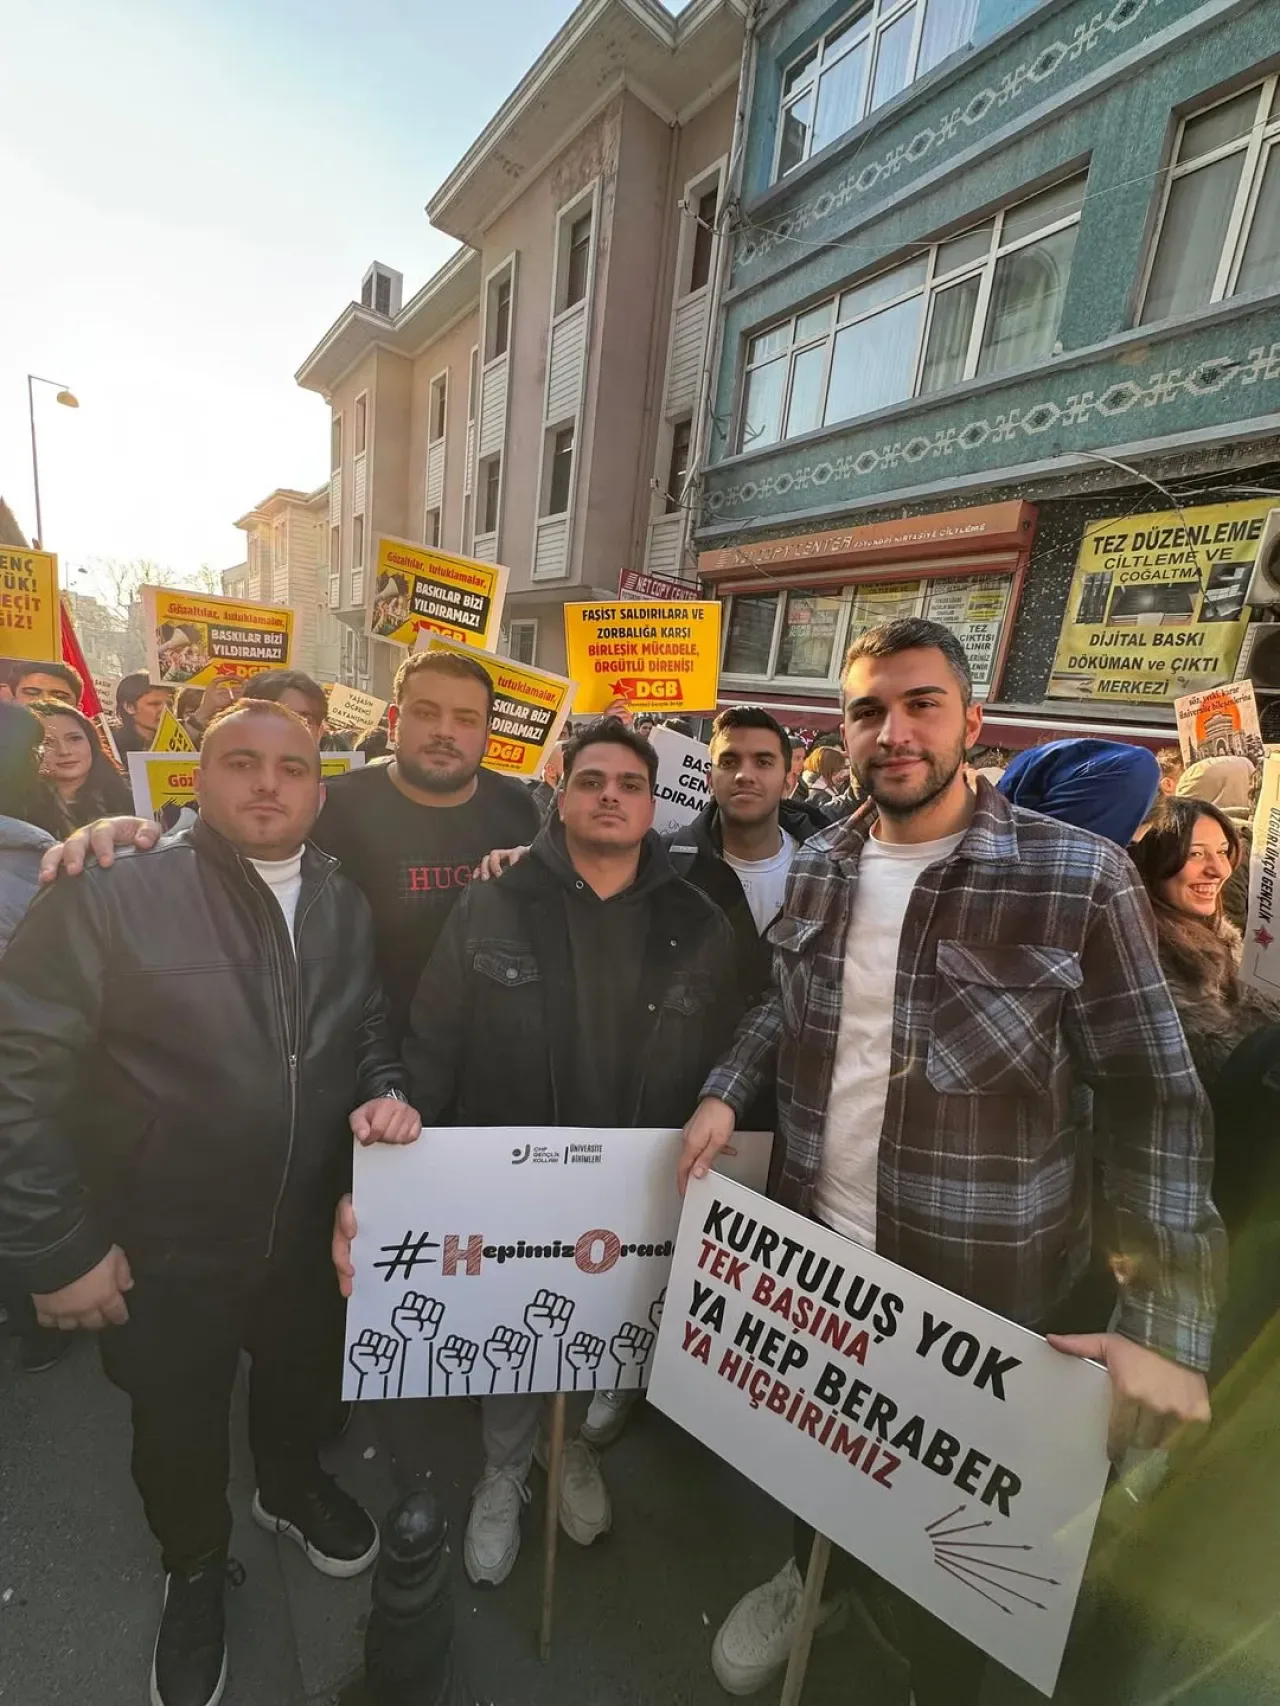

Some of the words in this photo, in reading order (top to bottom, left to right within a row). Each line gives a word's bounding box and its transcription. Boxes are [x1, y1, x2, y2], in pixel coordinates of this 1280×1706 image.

[794, 536, 853, 557] CENTER
[1093, 533, 1129, 556] TEZ
[1131, 518, 1264, 552] DÜZENLEME
[1104, 551, 1197, 570] CİLTLEME
[1206, 547, 1234, 561] VE
[0, 571, 37, 592] ÜK!
[1119, 566, 1203, 583] ÇOĞALTMA
[415, 582, 461, 604] BASKILAR
[463, 595, 484, 611] BİZİ
[414, 598, 480, 628] YILDIRAMAZ!
[582, 606, 616, 621] FAŞİST
[620, 608, 689, 620] SALDIRILARA
[692, 608, 705, 620] VE
[211, 629, 261, 643] BASKILAR
[264, 633, 283, 644] BİZİ
[597, 624, 657, 639] ZORBALIĞA
[661, 626, 691, 640] KARŞI
[968, 624, 988, 633] TEZ
[1089, 629, 1147, 647] DİJİTAL
[1152, 632, 1206, 647] BASKI
[588, 642, 638, 657] BİRLEŞİK
[641, 641, 700, 656] MÜCADELE,
[594, 658, 645, 673] ÖRGÜTLÜ
[648, 658, 694, 673] DİRENİŞ!
[1068, 653, 1144, 670] DÖKÜMAN
[1148, 659, 1166, 671] ve
[1170, 656, 1218, 675] ÇIKTI
[636, 681, 678, 698] DGB
[1097, 679, 1170, 695] MERKEZİ
[349, 693, 374, 707] YAŞASIN
[530, 707, 551, 724] BİZİ
[488, 716, 543, 740] DIRAMAZ!
[488, 740, 523, 761] DGB
[679, 774, 711, 795] GEN
[408, 865, 474, 891] HUG
[1257, 876, 1274, 924] GENÇLİK
[373, 1228, 676, 1282] #HepimizOrad
[697, 1239, 750, 1292] TEK
[751, 1272, 870, 1366] BAŞINA
[702, 1199, 904, 1344] KURTULUŞ
[915, 1311, 1023, 1402] YOK
[681, 1320, 712, 1365] YA
[718, 1356, 902, 1490] HİÇBİRİMİZ
[688, 1280, 727, 1334] YA
[733, 1312, 808, 1376] HEP
[813, 1362, 1022, 1518] BERABER
